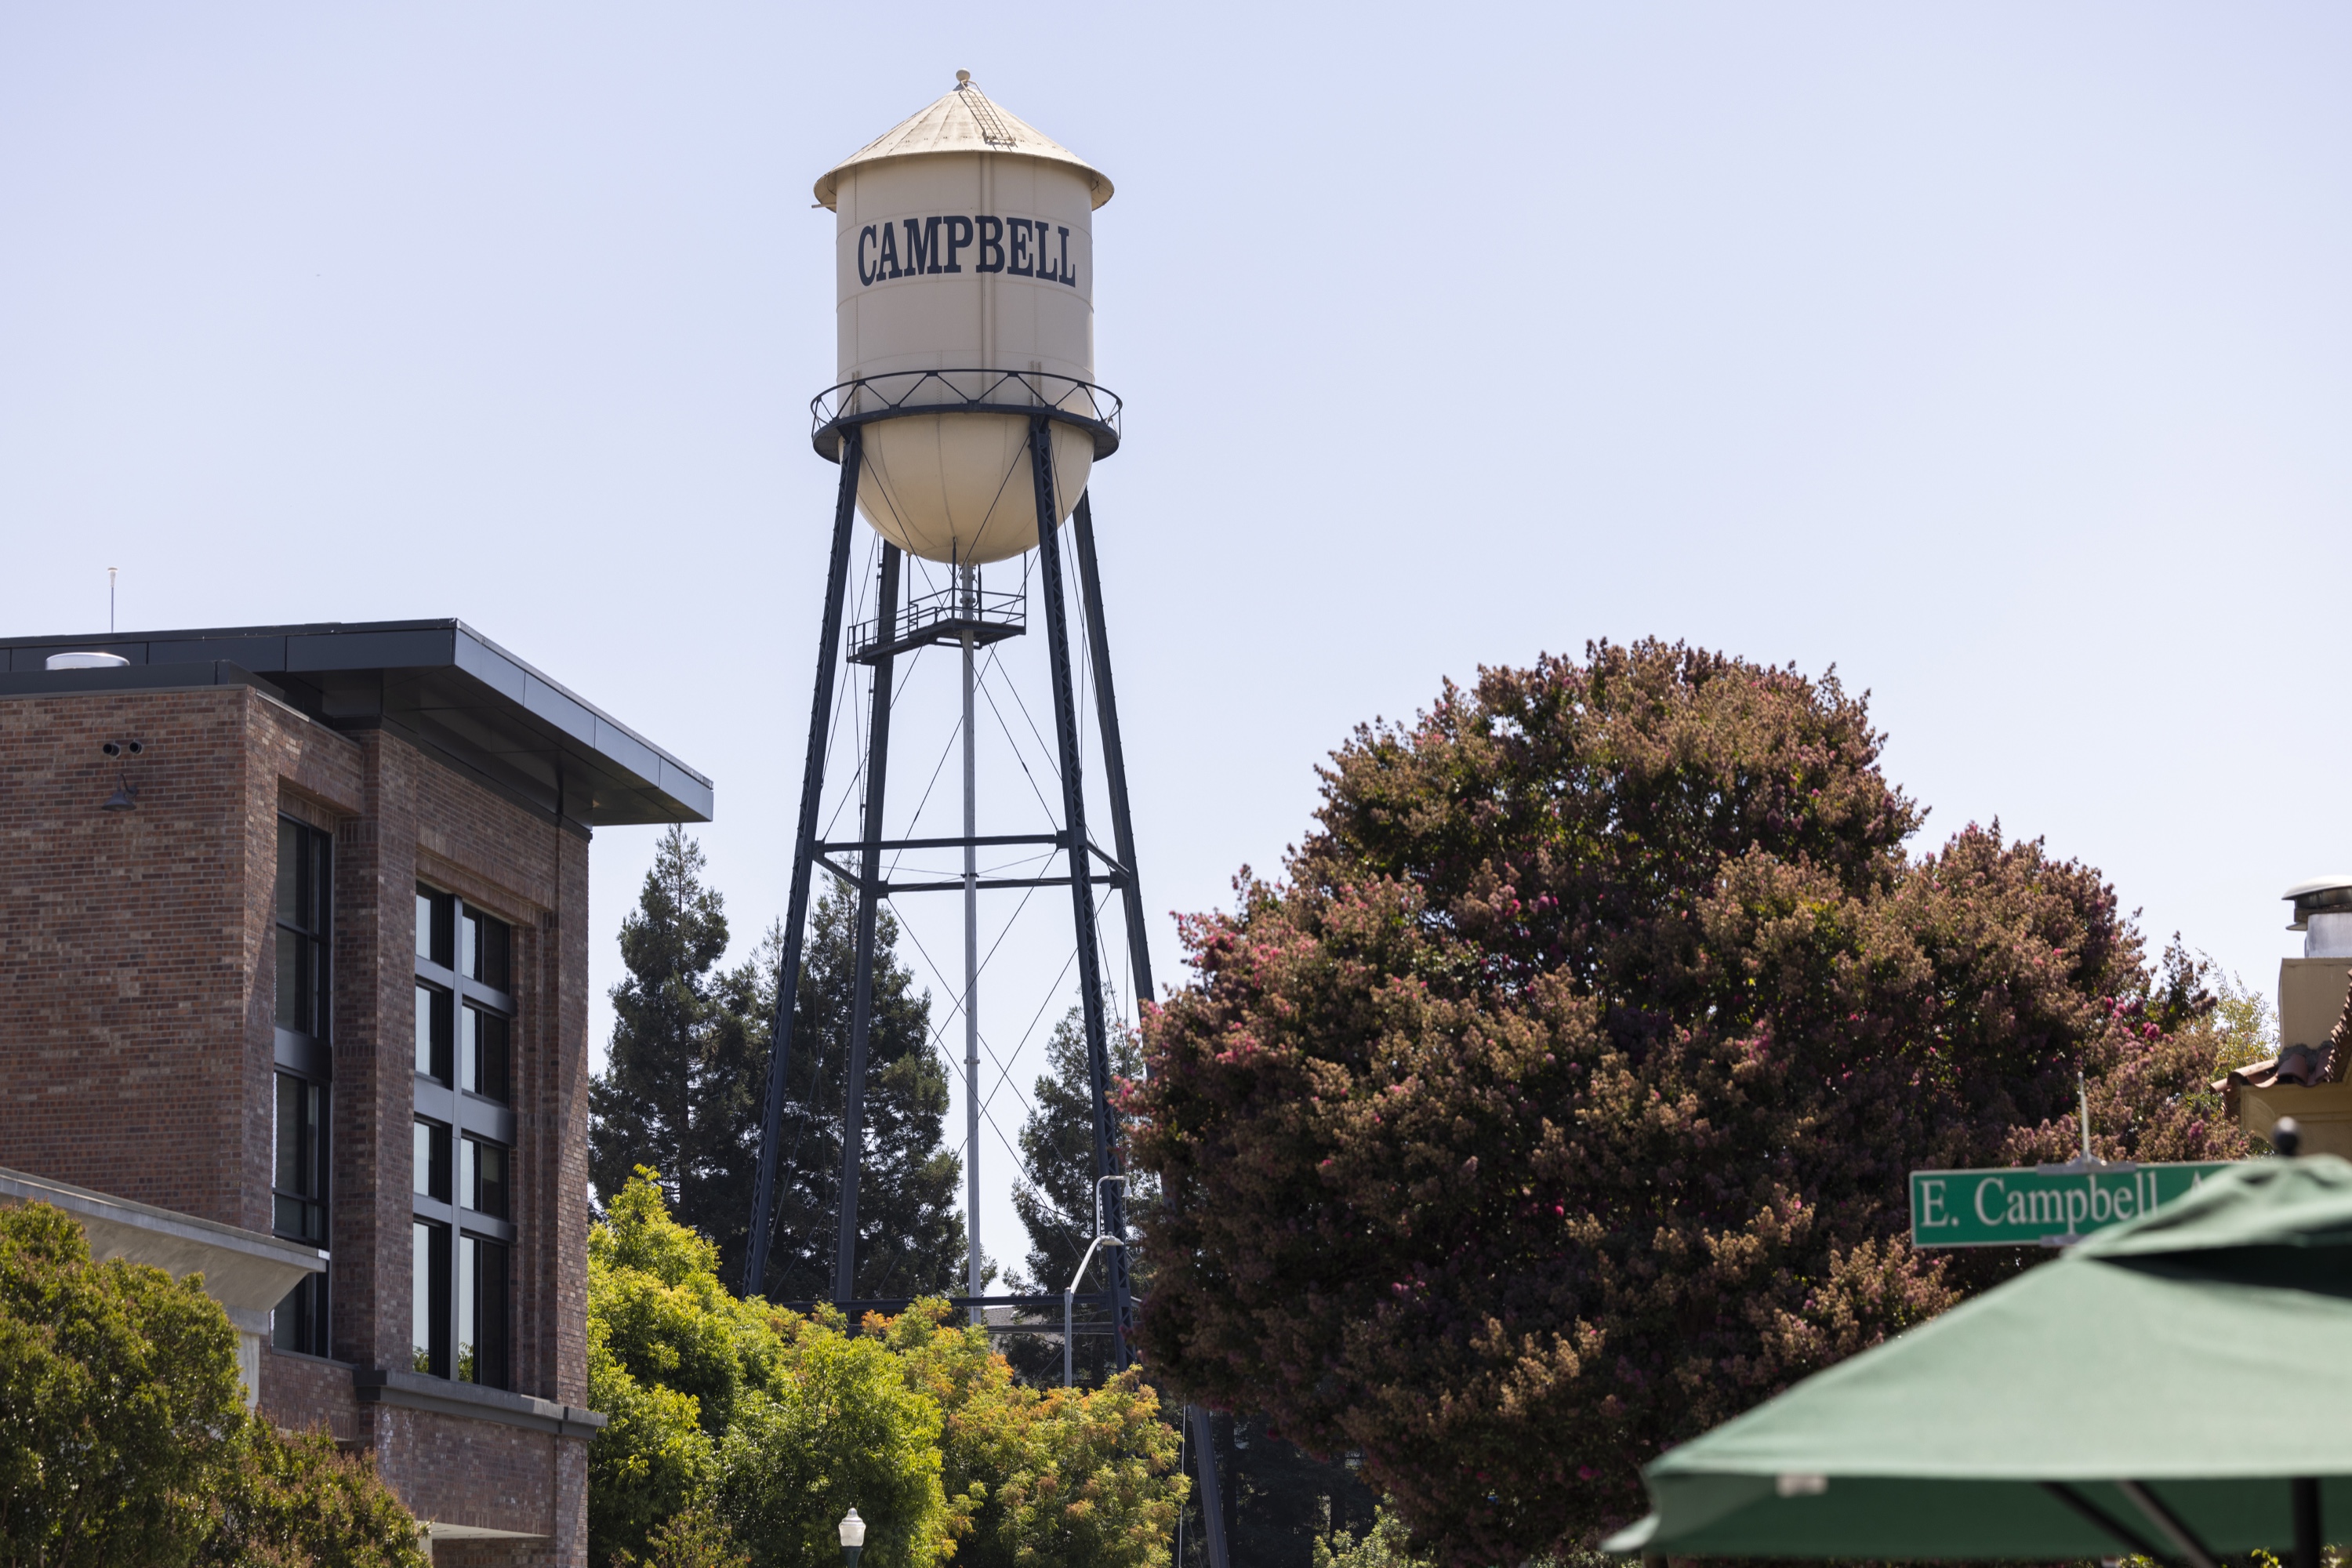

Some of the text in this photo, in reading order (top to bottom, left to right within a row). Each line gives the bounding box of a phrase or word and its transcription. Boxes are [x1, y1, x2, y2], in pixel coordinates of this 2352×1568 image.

[858, 215, 1076, 288] CAMPBELL
[1918, 1171, 2158, 1236] E. Campbell
